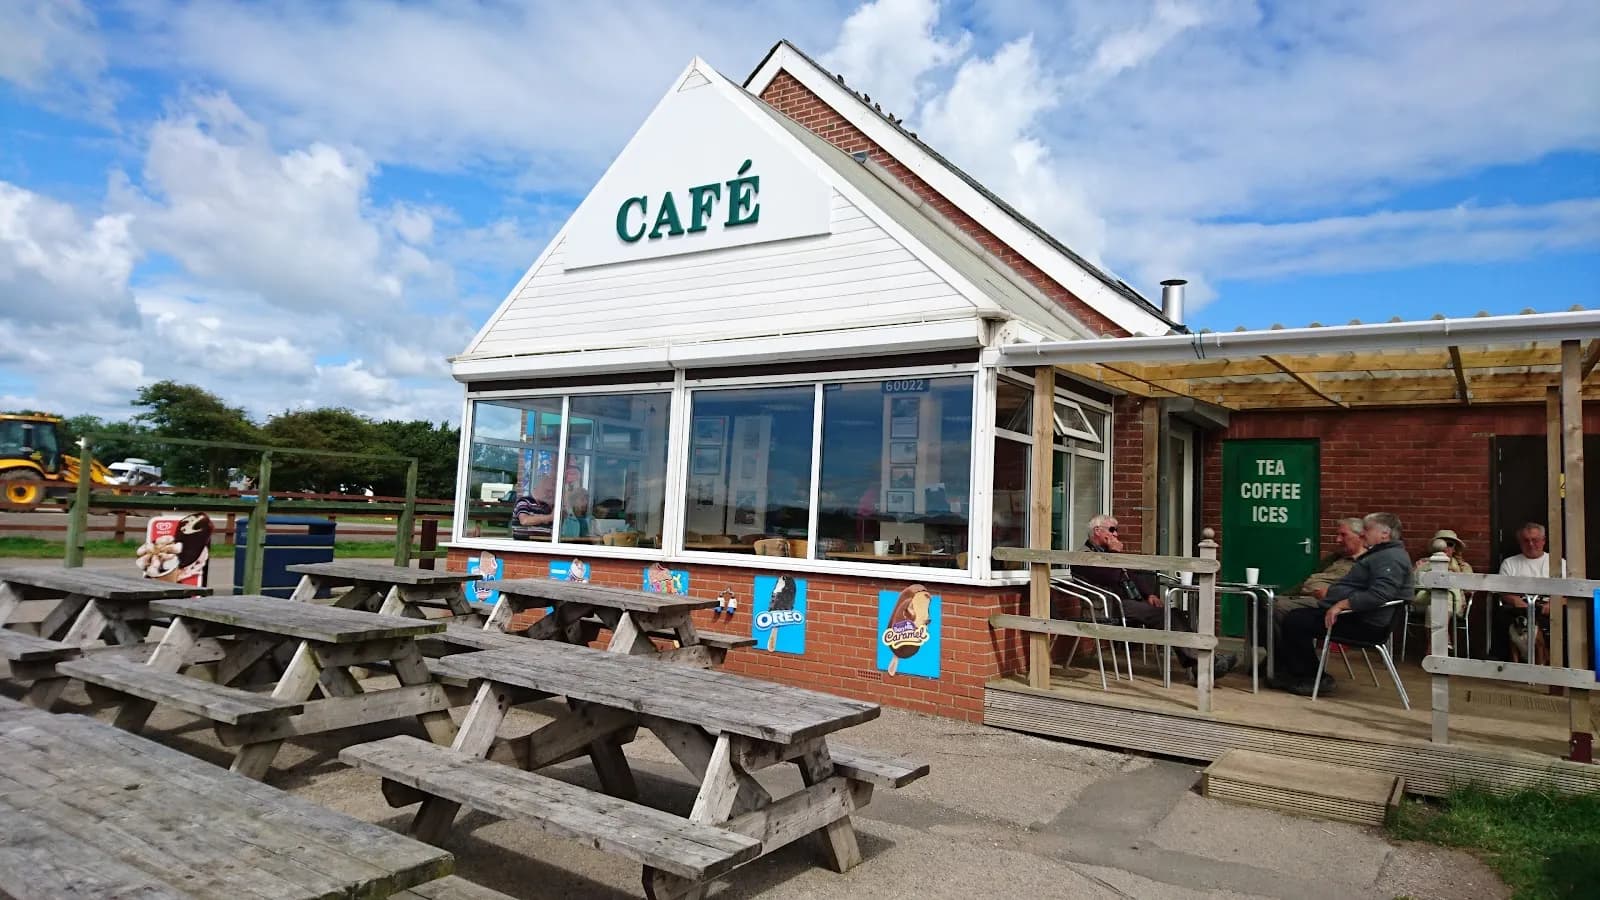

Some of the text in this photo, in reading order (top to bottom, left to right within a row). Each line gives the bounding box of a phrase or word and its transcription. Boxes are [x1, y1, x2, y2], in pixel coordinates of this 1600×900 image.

[616, 158, 760, 243] CAFÉ
[885, 380, 924, 392] 60022
[1255, 459, 1286, 476] TEA
[1240, 482, 1301, 500] COFFEE
[1252, 505, 1289, 524] ICES
[756, 611, 802, 628] OREO
[884, 626, 928, 644] Caramel
